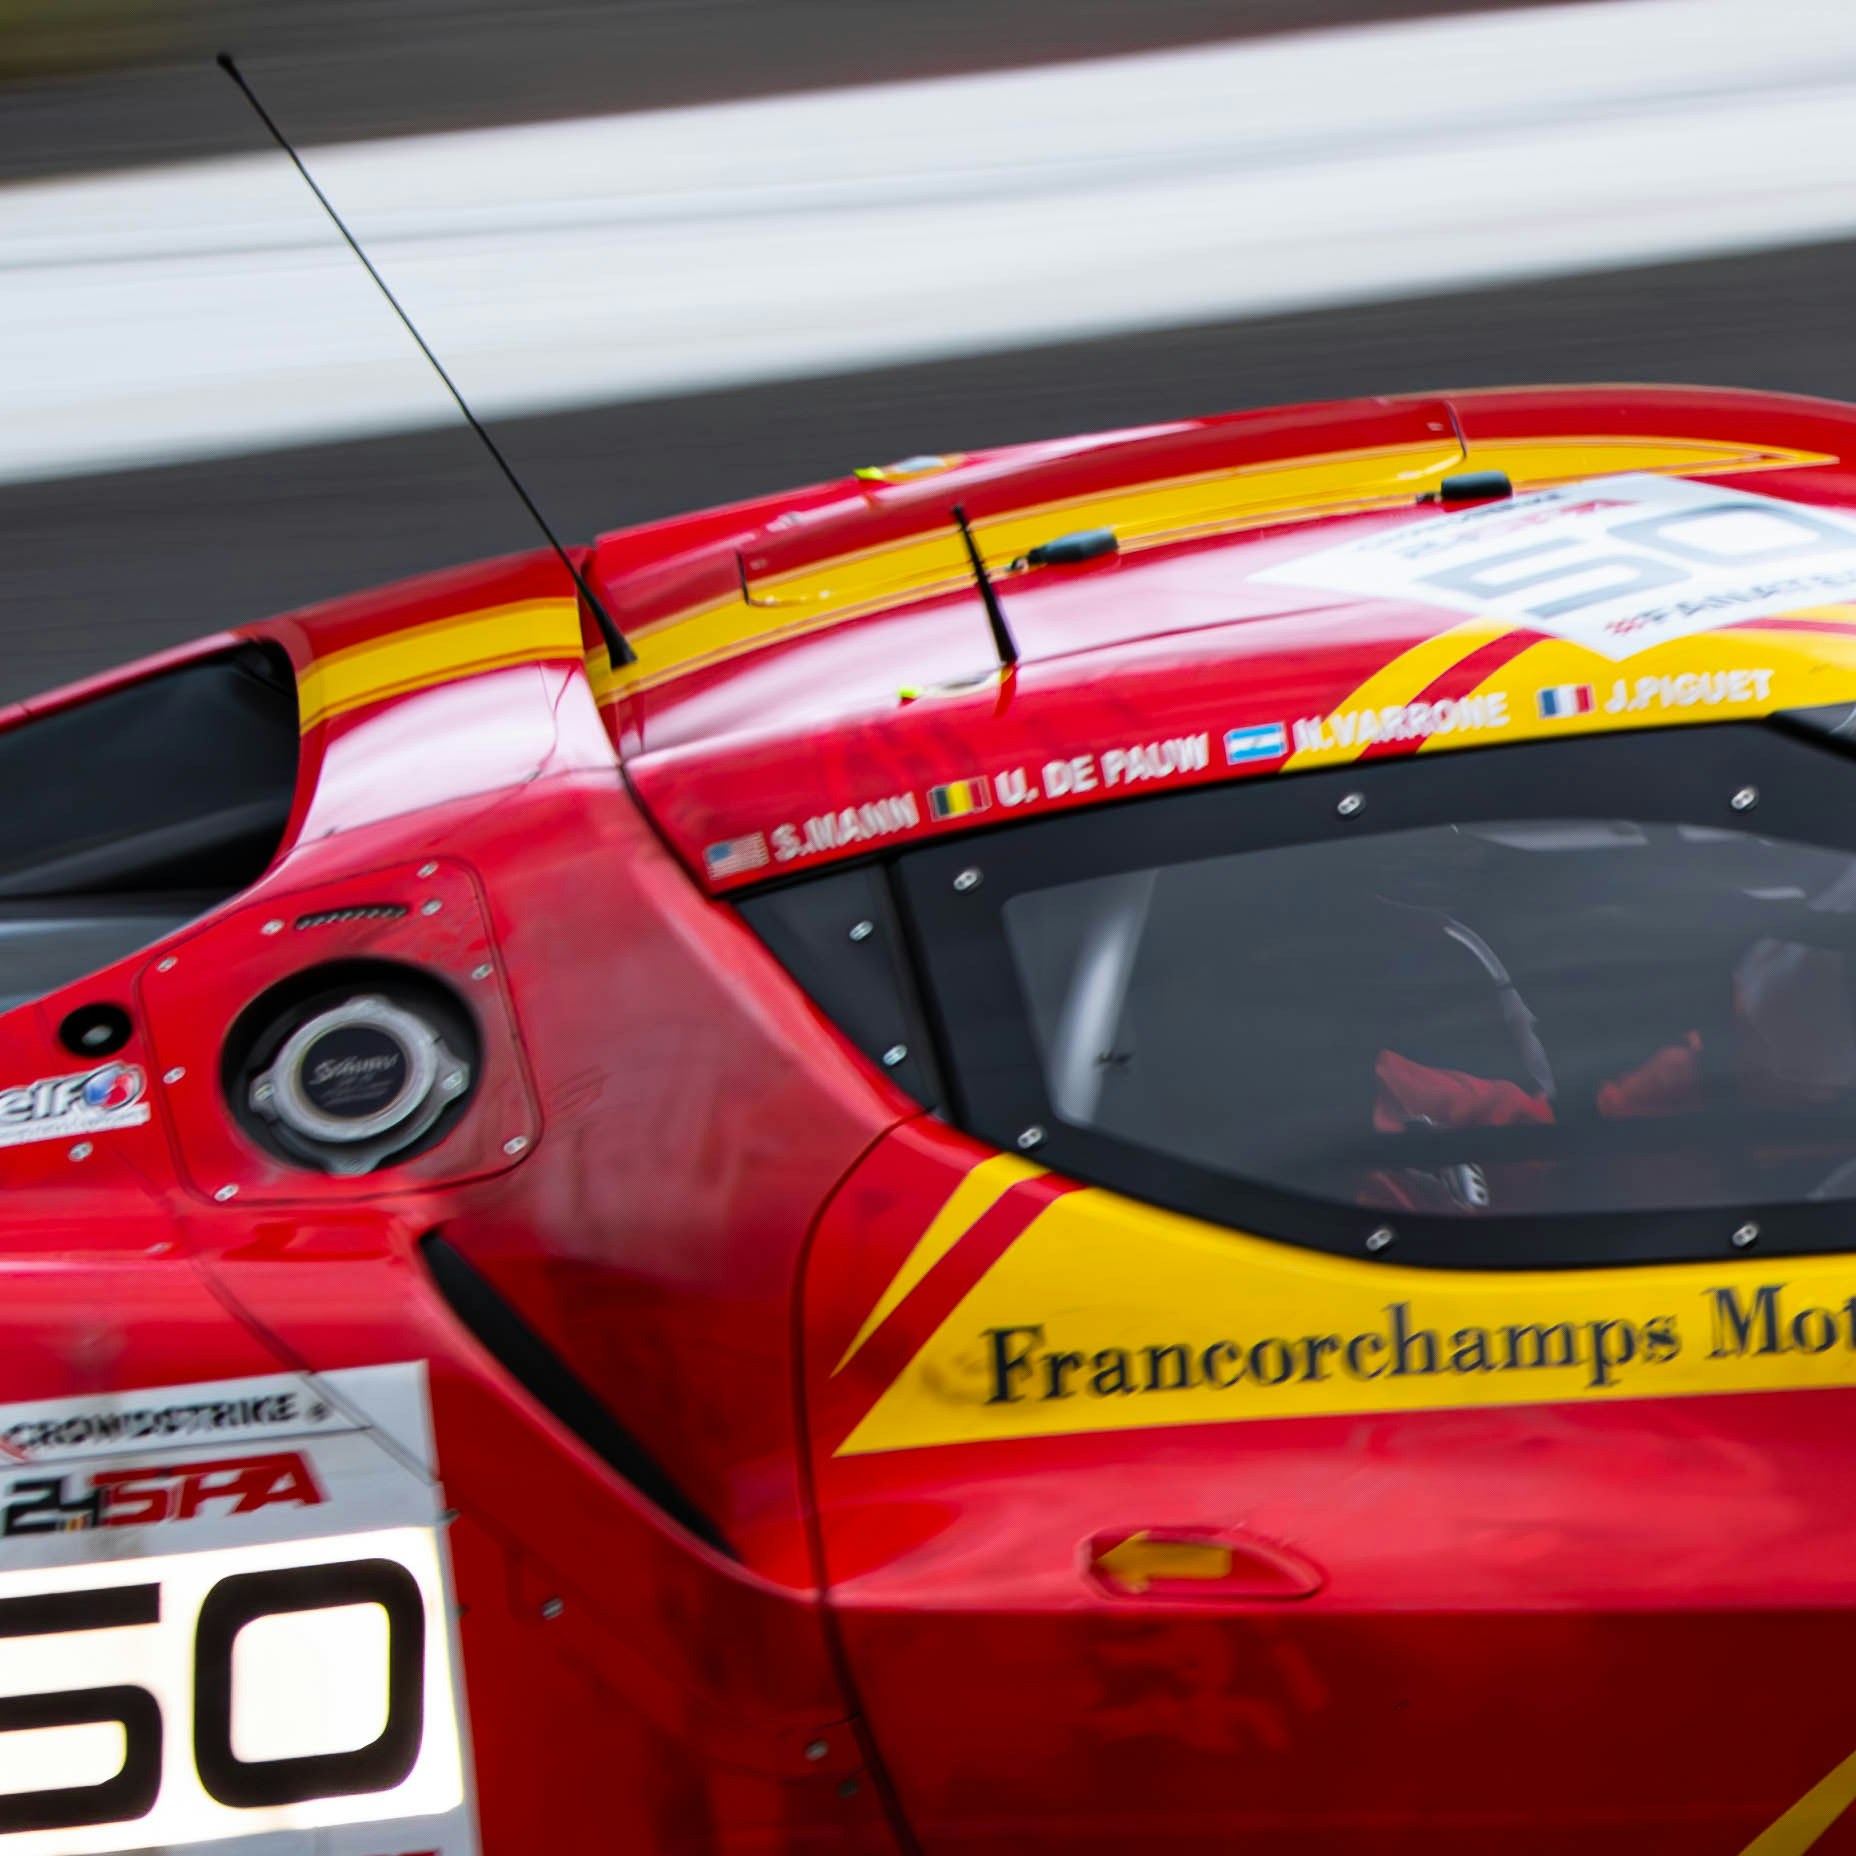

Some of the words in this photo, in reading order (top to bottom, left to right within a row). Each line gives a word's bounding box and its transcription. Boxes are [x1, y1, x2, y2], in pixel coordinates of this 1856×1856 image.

[1292, 690, 1511, 755] N.VARRONE
[1604, 667, 1775, 715] J.PIGUET
[994, 765, 1040, 807] U.
[1041, 753, 1099, 801] DE
[1099, 731, 1210, 788] PAUW
[981, 1302, 1682, 1405] Francorchamps
